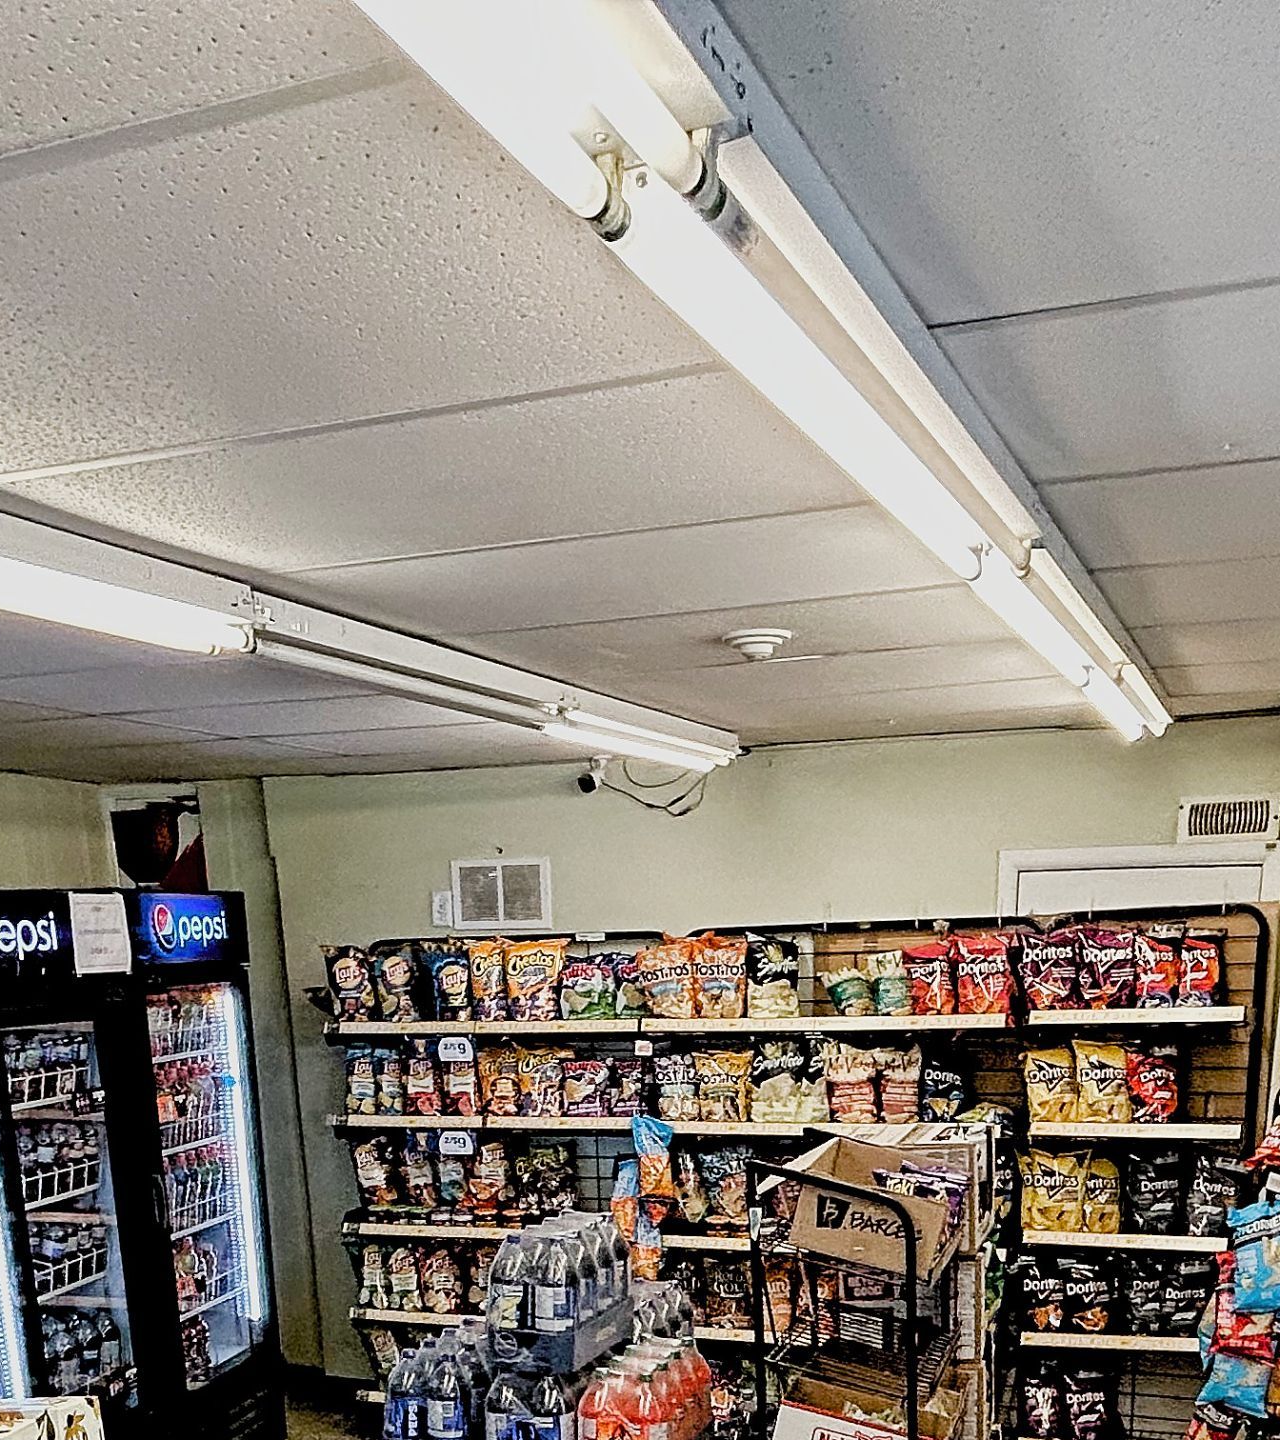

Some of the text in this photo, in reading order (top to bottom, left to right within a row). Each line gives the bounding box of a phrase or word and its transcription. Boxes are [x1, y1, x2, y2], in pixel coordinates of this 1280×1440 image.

[177, 910, 228, 945] pepsi
[1022, 946, 1074, 963] Doritos
[507, 950, 556, 976] Cheetos
[1140, 1179, 1180, 1192] Doritos
[1165, 1287, 1206, 1300] Doritos
[1065, 1390, 1106, 1405] Doritos
